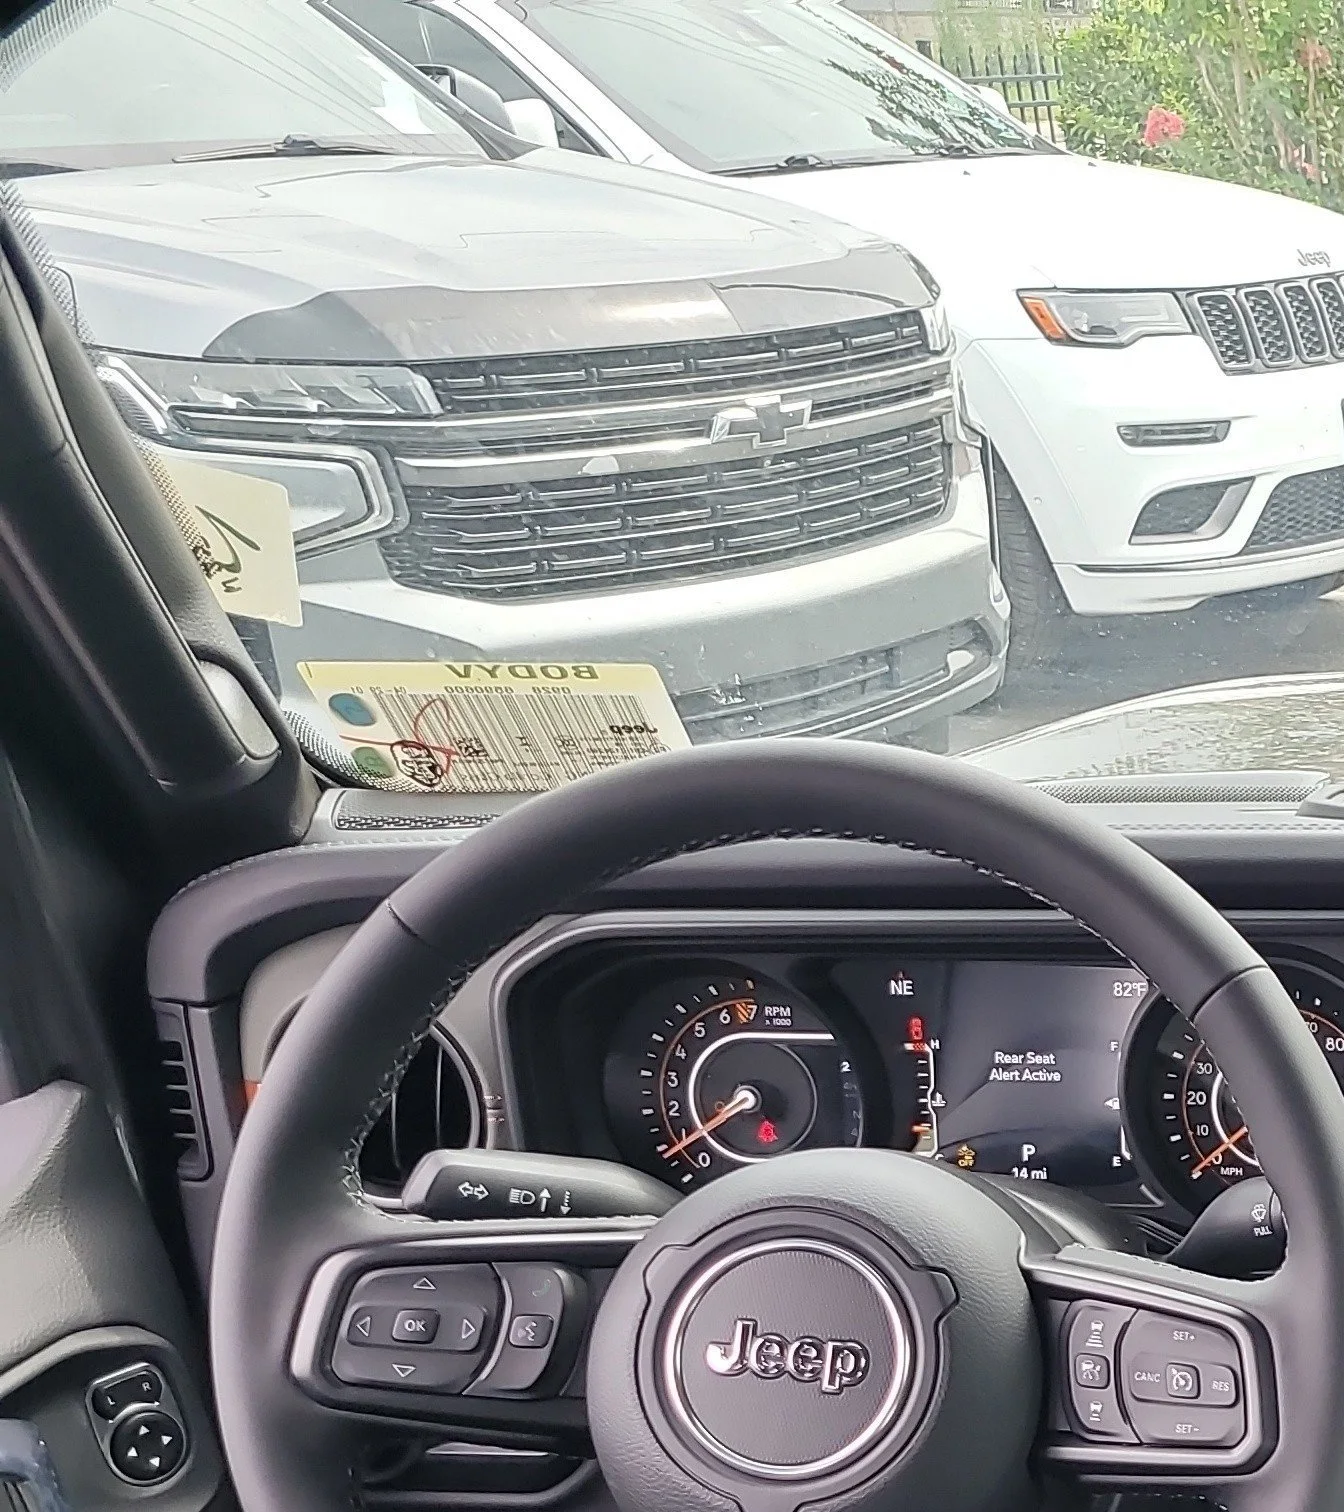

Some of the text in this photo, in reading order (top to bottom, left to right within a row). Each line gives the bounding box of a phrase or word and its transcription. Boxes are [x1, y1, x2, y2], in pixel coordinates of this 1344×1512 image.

[1297, 248, 1331, 268] Jeep
[890, 980, 914, 995] NE
[1113, 982, 1147, 996] 82°F
[720, 1009, 731, 1024] 6
[747, 1005, 758, 1020] 7
[764, 1006, 791, 1017] RPM
[694, 1023, 706, 1037] 5
[930, 1040, 940, 1049] H
[1110, 1042, 1118, 1051] F
[675, 1045, 686, 1060] 4
[994, 1052, 1055, 1065] Rear Seat
[989, 1068, 1061, 1082] Alert Active
[1196, 1063, 1213, 1074] 30
[667, 1072, 678, 1087] 3
[1187, 1091, 1206, 1105] 20
[669, 1101, 680, 1117] 2
[1196, 1124, 1209, 1136] 10
[699, 1152, 711, 1168] 0
[1022, 1145, 1036, 1161] P
[958, 1158, 974, 1167] OFF
[1112, 1157, 1121, 1167] E
[1012, 1166, 1047, 1180] 14 mi
[1220, 1166, 1243, 1176] MPH
[403, 1318, 426, 1332] OK
[705, 1317, 872, 1395] Jeep
[1134, 1371, 1161, 1383] CANC
[142, 1381, 152, 1391] R
[1211, 1380, 1230, 1392] RES
[106, 1397, 116, 1406] L
